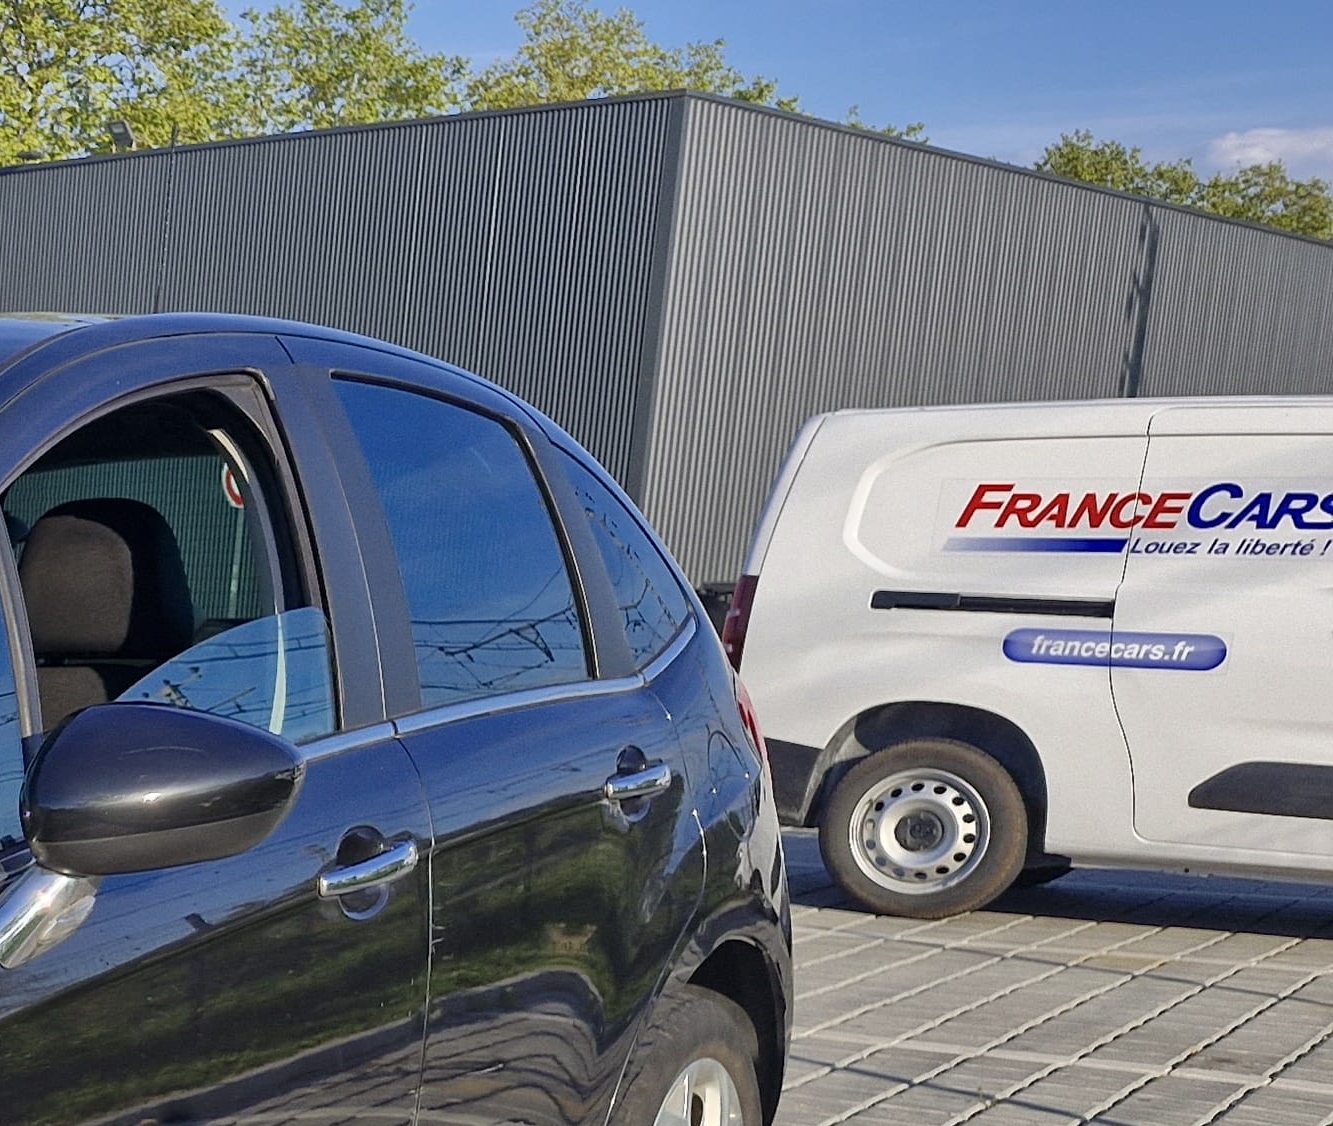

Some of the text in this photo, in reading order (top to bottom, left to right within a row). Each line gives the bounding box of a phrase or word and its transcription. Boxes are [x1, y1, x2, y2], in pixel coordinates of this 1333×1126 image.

[1130, 537, 1201, 554] Louez
[1207, 538, 1230, 554] la
[1235, 538, 1316, 556] liberté
[1031, 635, 1194, 661] francecars.fr
